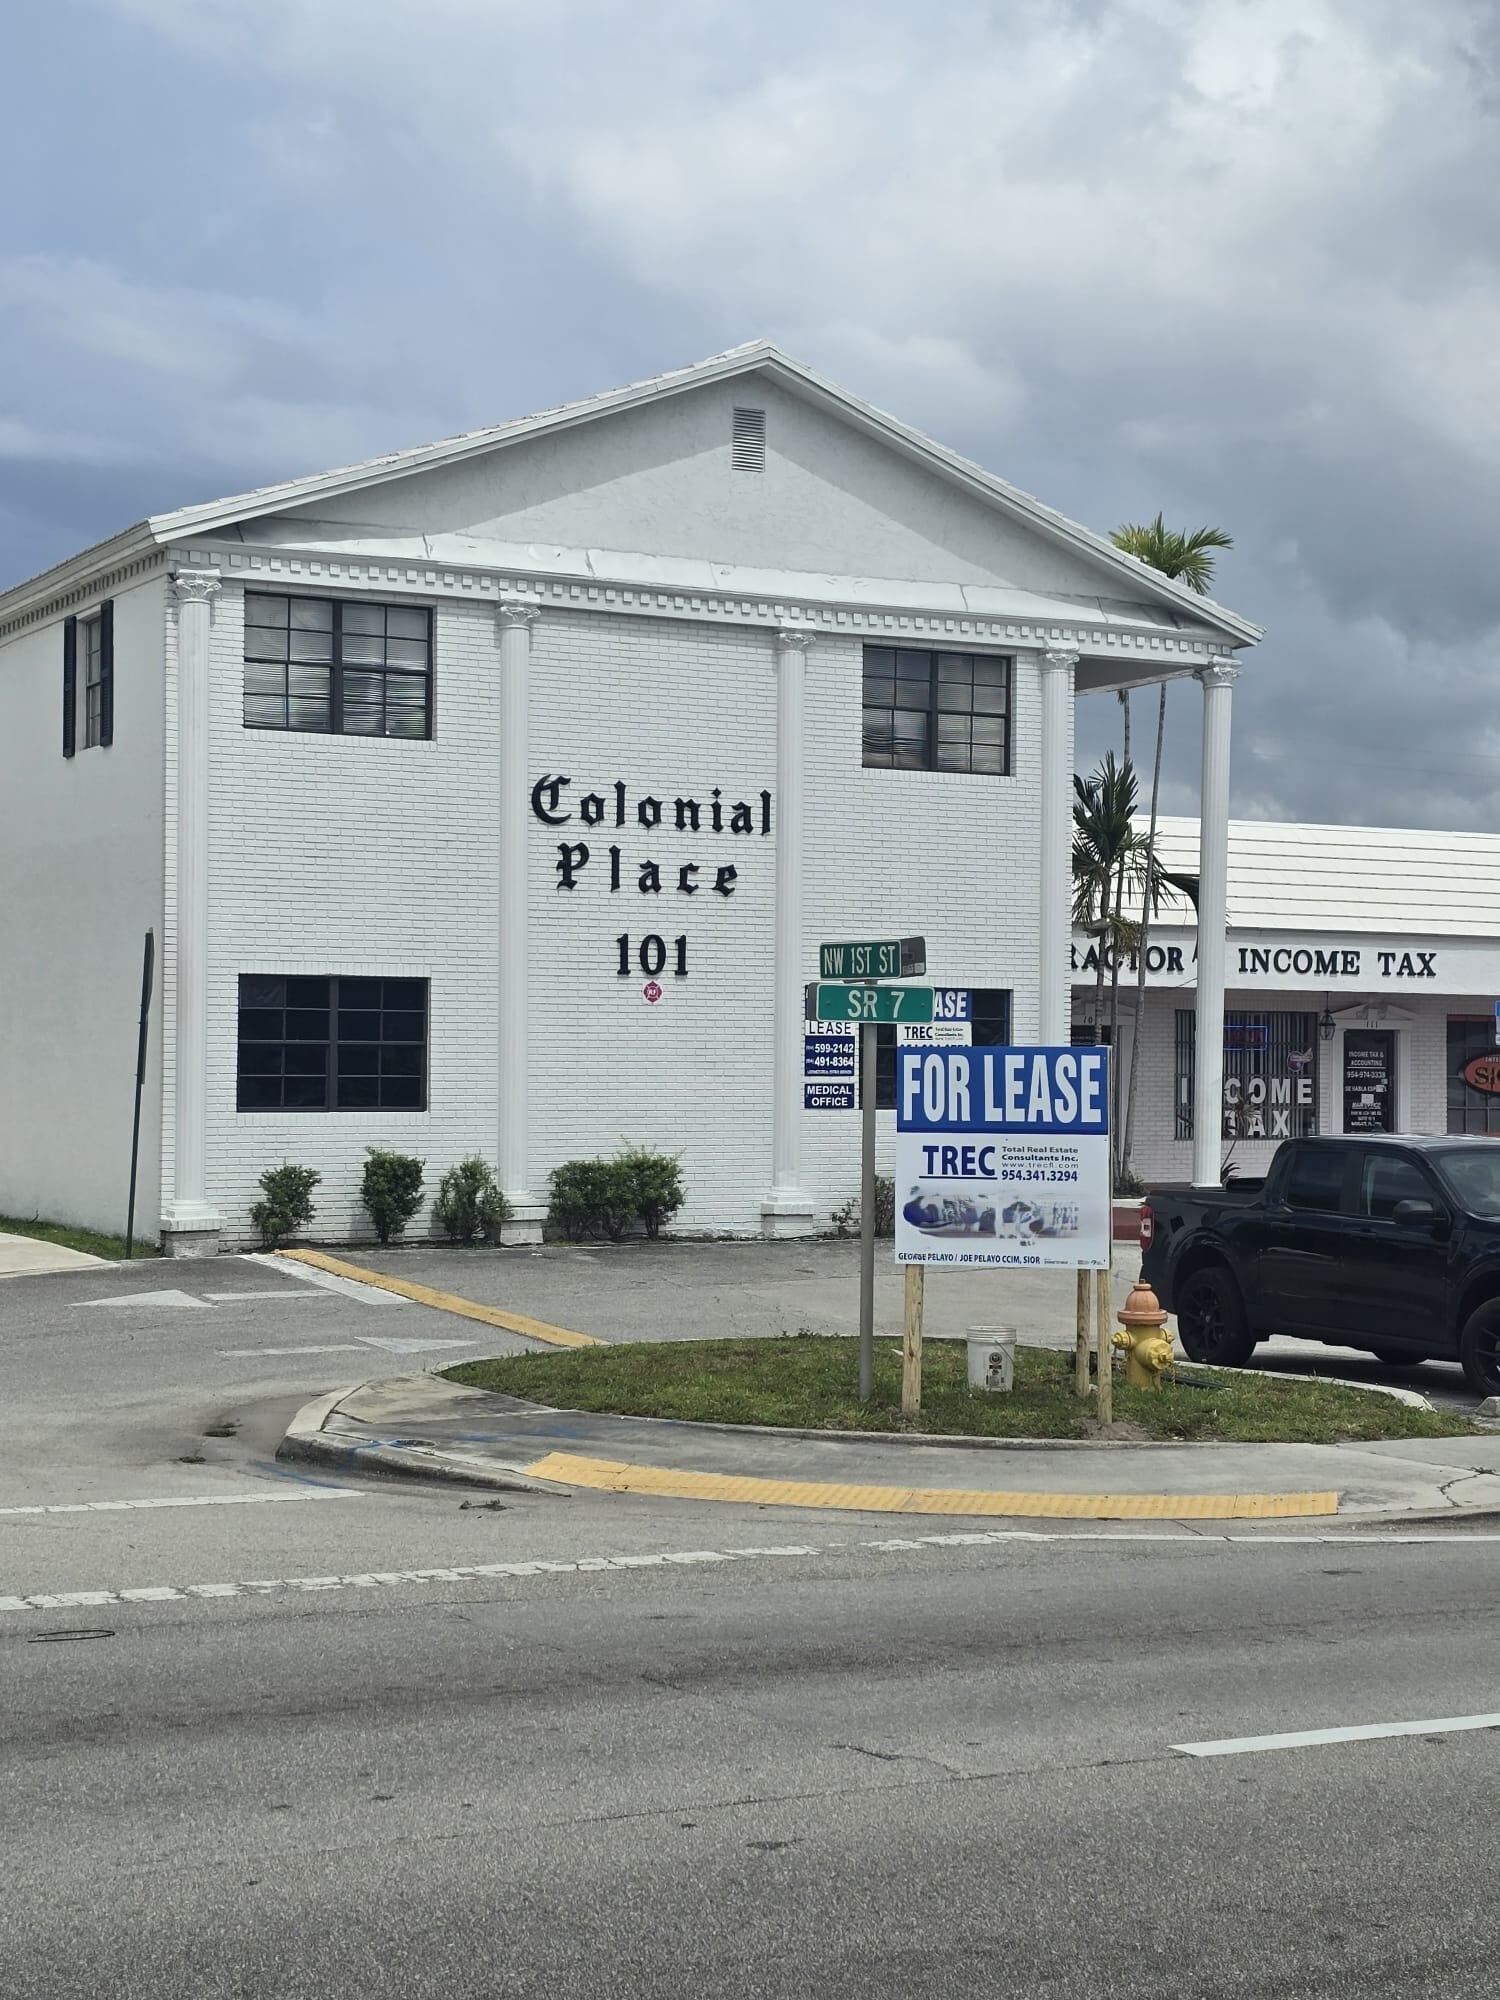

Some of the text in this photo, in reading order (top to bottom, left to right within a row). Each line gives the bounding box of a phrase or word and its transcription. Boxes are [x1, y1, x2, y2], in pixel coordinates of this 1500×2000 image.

[531, 774, 772, 836] Colonial
[556, 842, 738, 897] Place
[616, 933, 689, 976] 101
[824, 945, 896, 975] NW 1ST ST
[1238, 948, 1437, 977] INCOME TAX
[847, 989, 905, 1018] SR 7
[809, 1021, 852, 1034] LEASE
[904, 1026, 933, 1039] TREC
[814, 1043, 854, 1053] 599-2142
[814, 1056, 854, 1066] 491-8364
[807, 1085, 853, 1095] MEDICAL
[903, 1053, 1101, 1124] FOR LEASE
[1181, 1077, 1313, 1104] ICOME
[811, 1097, 848, 1106] OFFICE
[922, 1145, 996, 1177] TREC
[1001, 1154, 1060, 1162] Consultants
[1001, 1169, 1078, 1182] 954.341.3294
[898, 1252, 927, 1261] GEORGE
[927, 1253, 954, 1261] PELAYO
[959, 1254, 973, 1262] JOE
[974, 1254, 1000, 1263] PELAYO
[1001, 1255, 1021, 1264] CCIM,
[1023, 1256, 1040, 1264] SIOR
